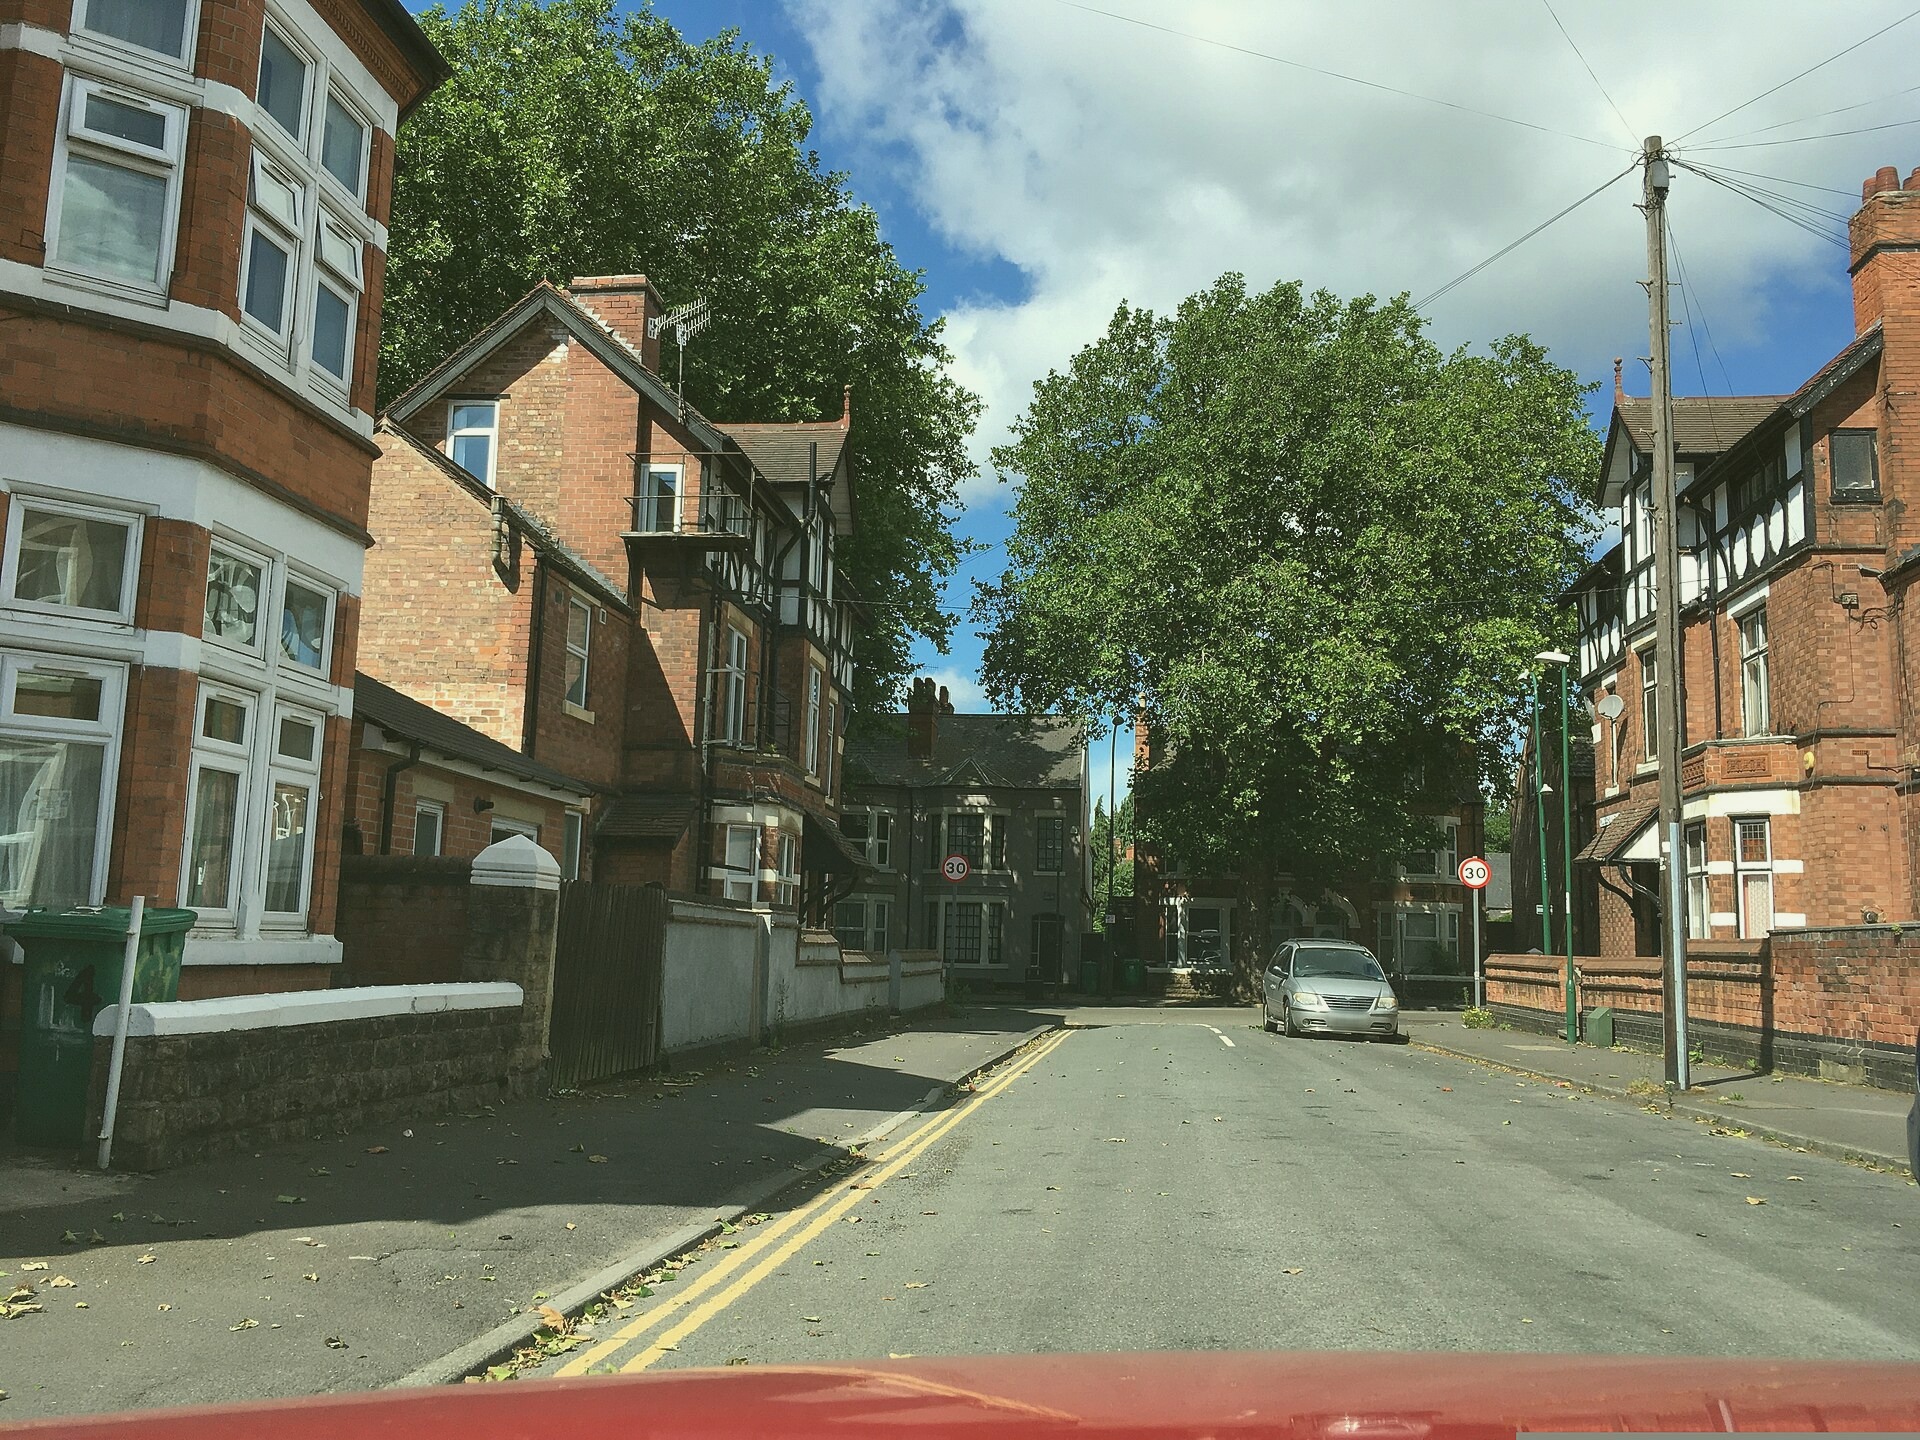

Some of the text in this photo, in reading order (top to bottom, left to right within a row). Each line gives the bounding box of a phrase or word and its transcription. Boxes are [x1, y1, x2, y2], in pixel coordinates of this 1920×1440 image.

[945, 861, 966, 874] 30
[1464, 867, 1486, 879] 30
[63, 964, 102, 1022] 4
